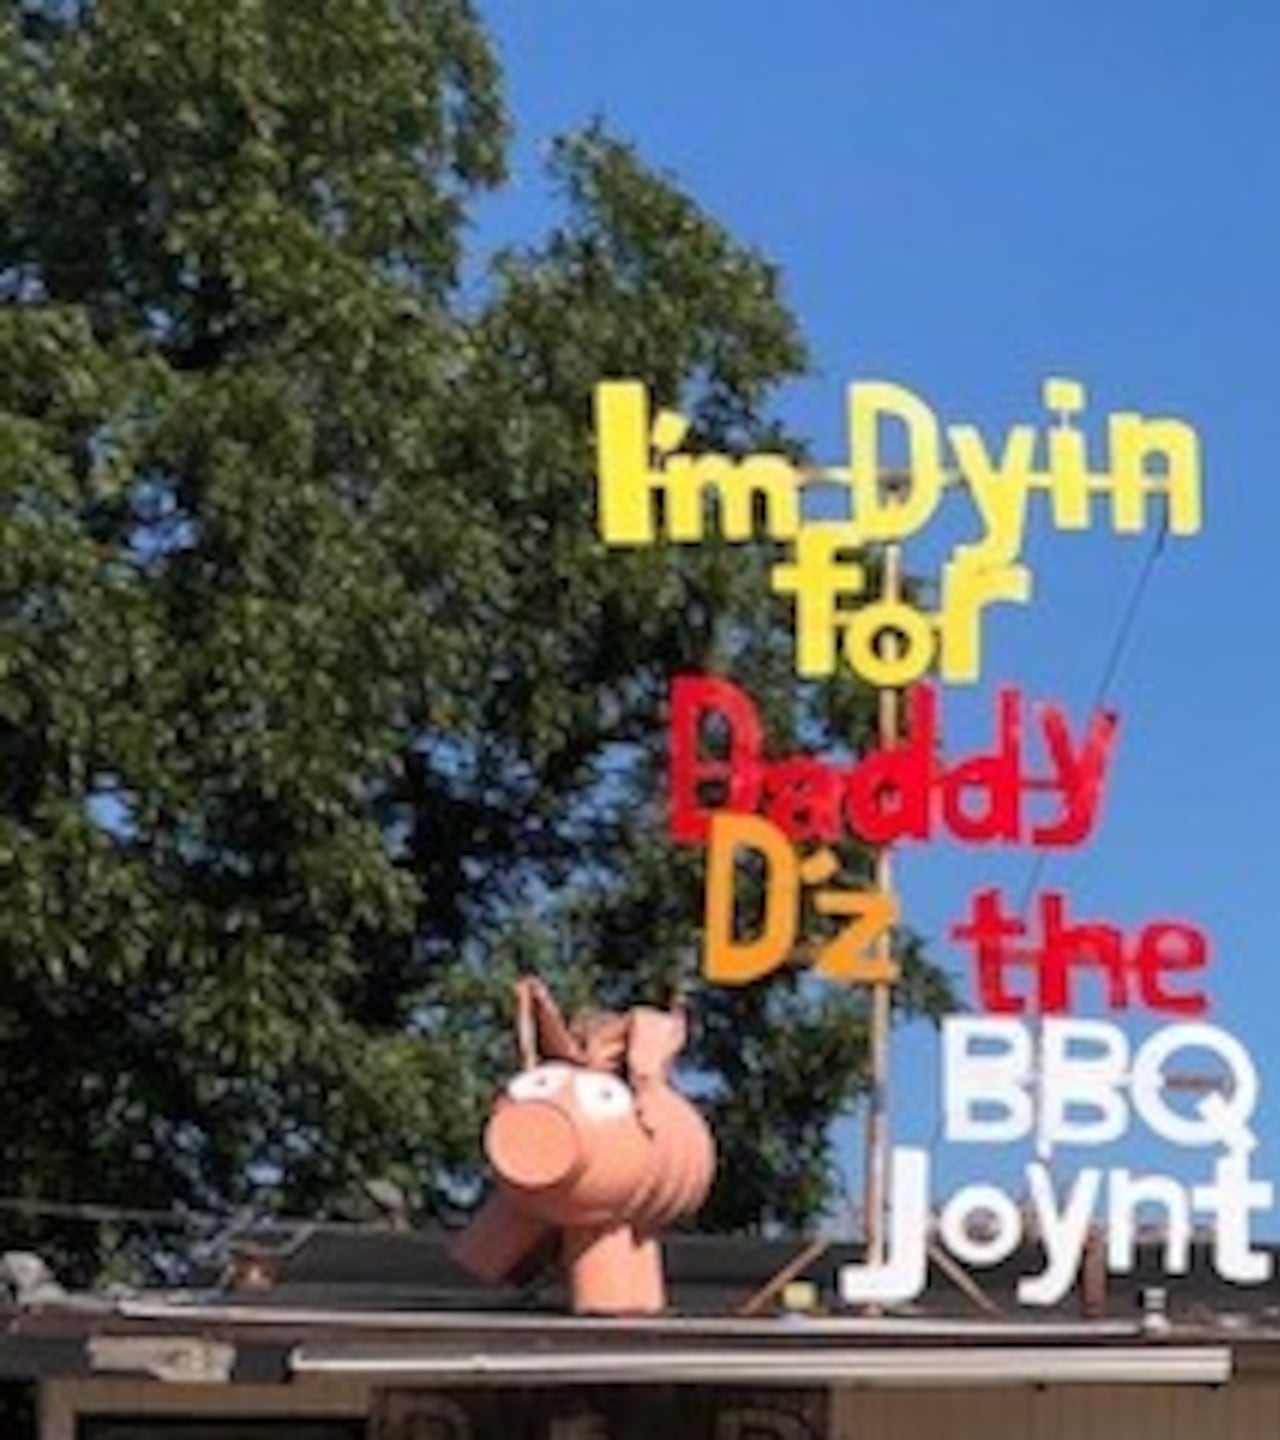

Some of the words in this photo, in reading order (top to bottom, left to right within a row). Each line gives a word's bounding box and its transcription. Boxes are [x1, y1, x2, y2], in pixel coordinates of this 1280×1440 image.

[595, 380, 798, 544] I'm
[848, 377, 1201, 566] Dyin
[773, 520, 1033, 686] for
[667, 671, 1122, 848] Daddy
[702, 811, 898, 985] D'z
[950, 885, 1214, 1018] the
[942, 1016, 1260, 1148] BBQ
[840, 1145, 1275, 1304] Joynt
